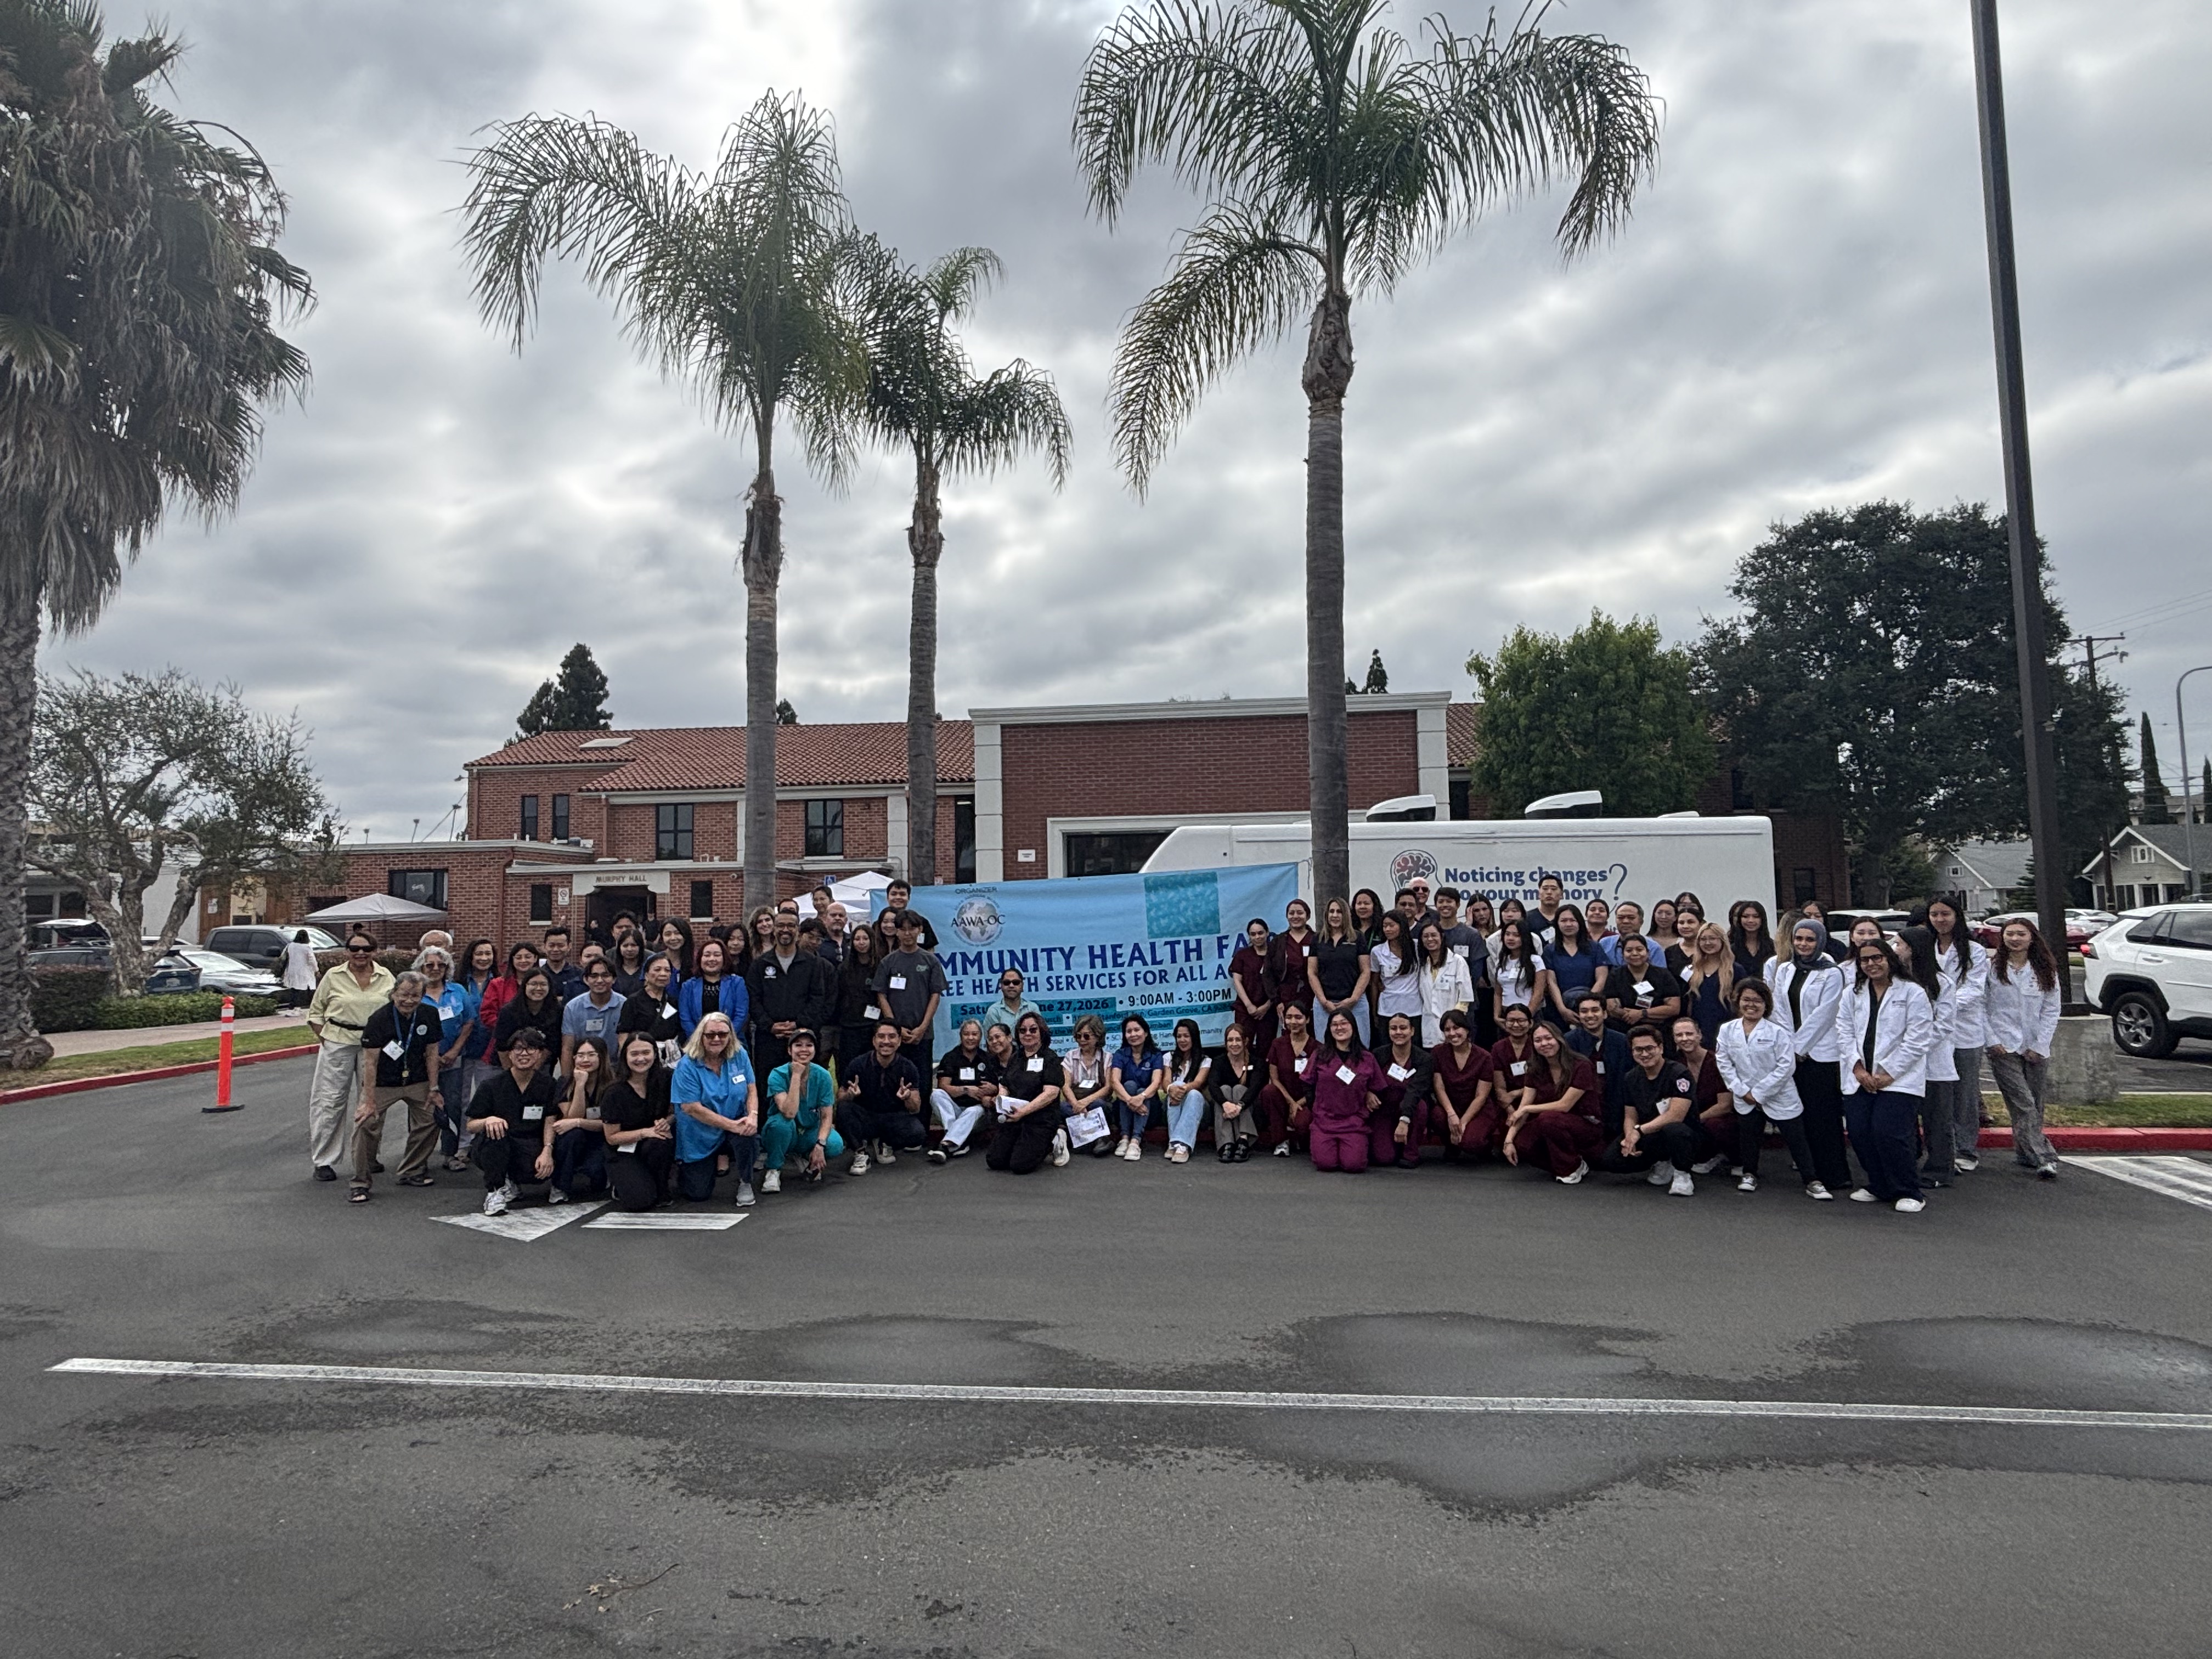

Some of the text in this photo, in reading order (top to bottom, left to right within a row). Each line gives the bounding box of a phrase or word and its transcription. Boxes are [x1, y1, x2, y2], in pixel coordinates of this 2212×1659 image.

[1445, 866, 1525, 886] Noticing
[1459, 889, 1471, 901] o
[951, 914, 1006, 927] AAWA-OC
[1088, 938, 1203, 970] HEALTH
[1046, 971, 1126, 992] SERVICES
[1133, 969, 1170, 986] FOR
[1176, 964, 1207, 983] ALL
[1057, 999, 1109, 1012] 27,2026
[1128, 992, 1174, 1007] 9:00AM
[1186, 988, 1231, 1003] 3:00PM
